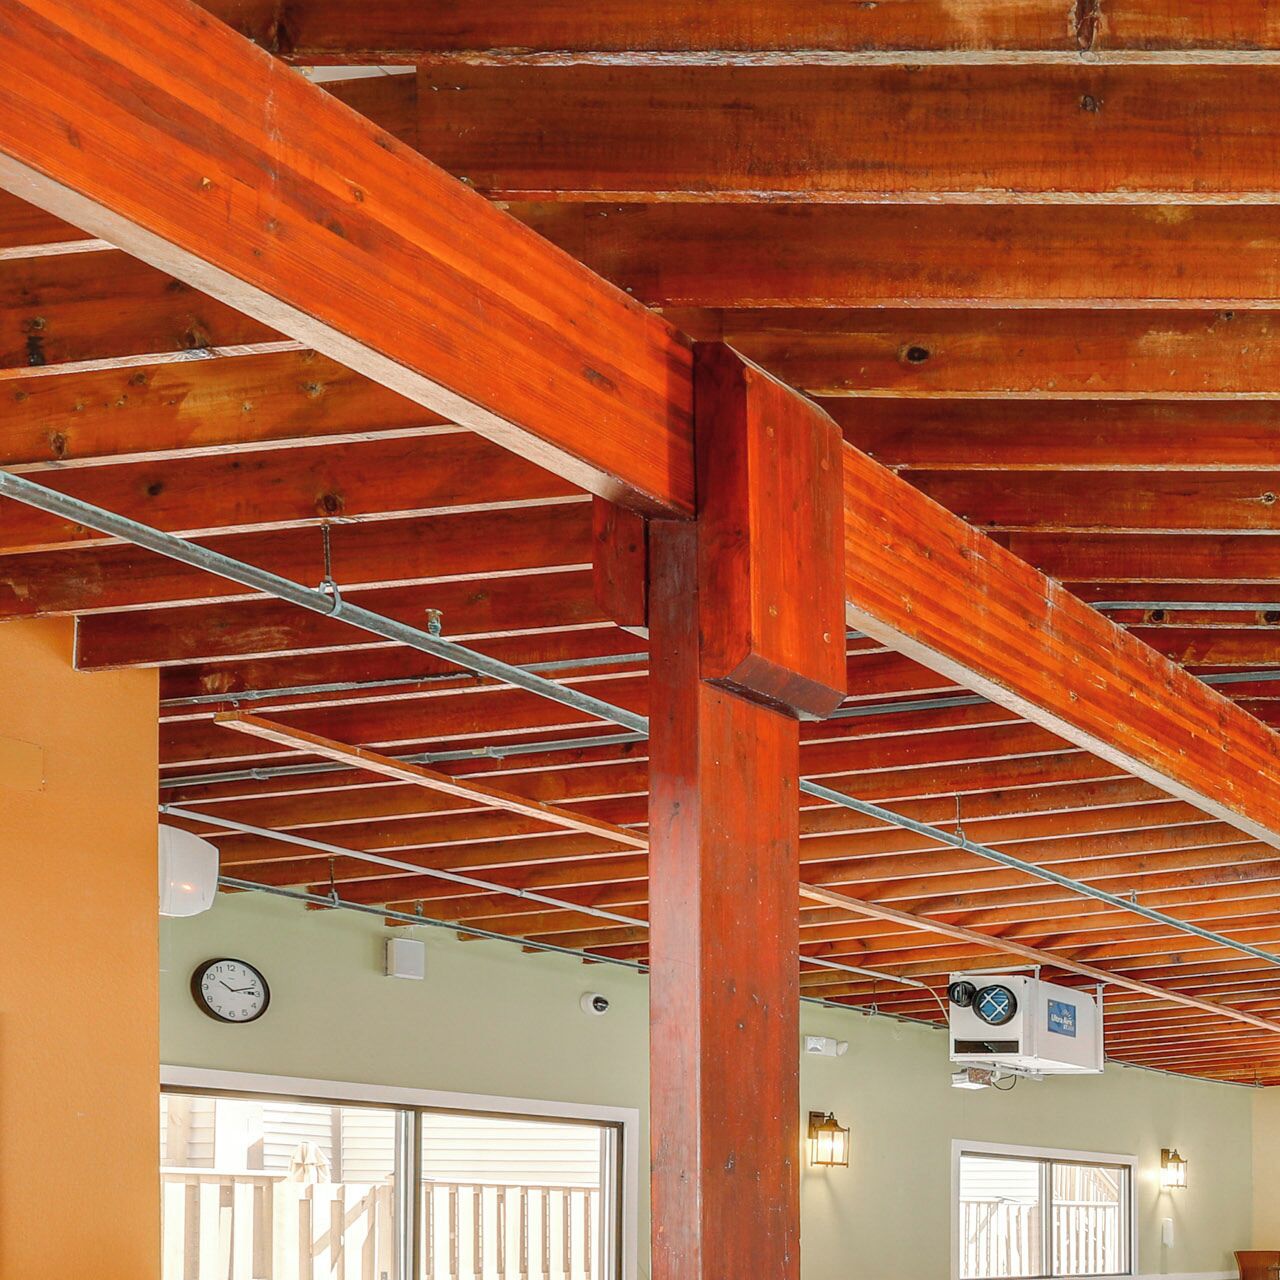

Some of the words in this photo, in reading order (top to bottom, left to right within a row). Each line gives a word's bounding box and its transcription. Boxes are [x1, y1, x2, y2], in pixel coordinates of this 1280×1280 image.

[216, 965, 223, 973] 11
[227, 964, 236, 972] 12
[206, 973, 216, 981] 10
[207, 995, 213, 1003] 8
